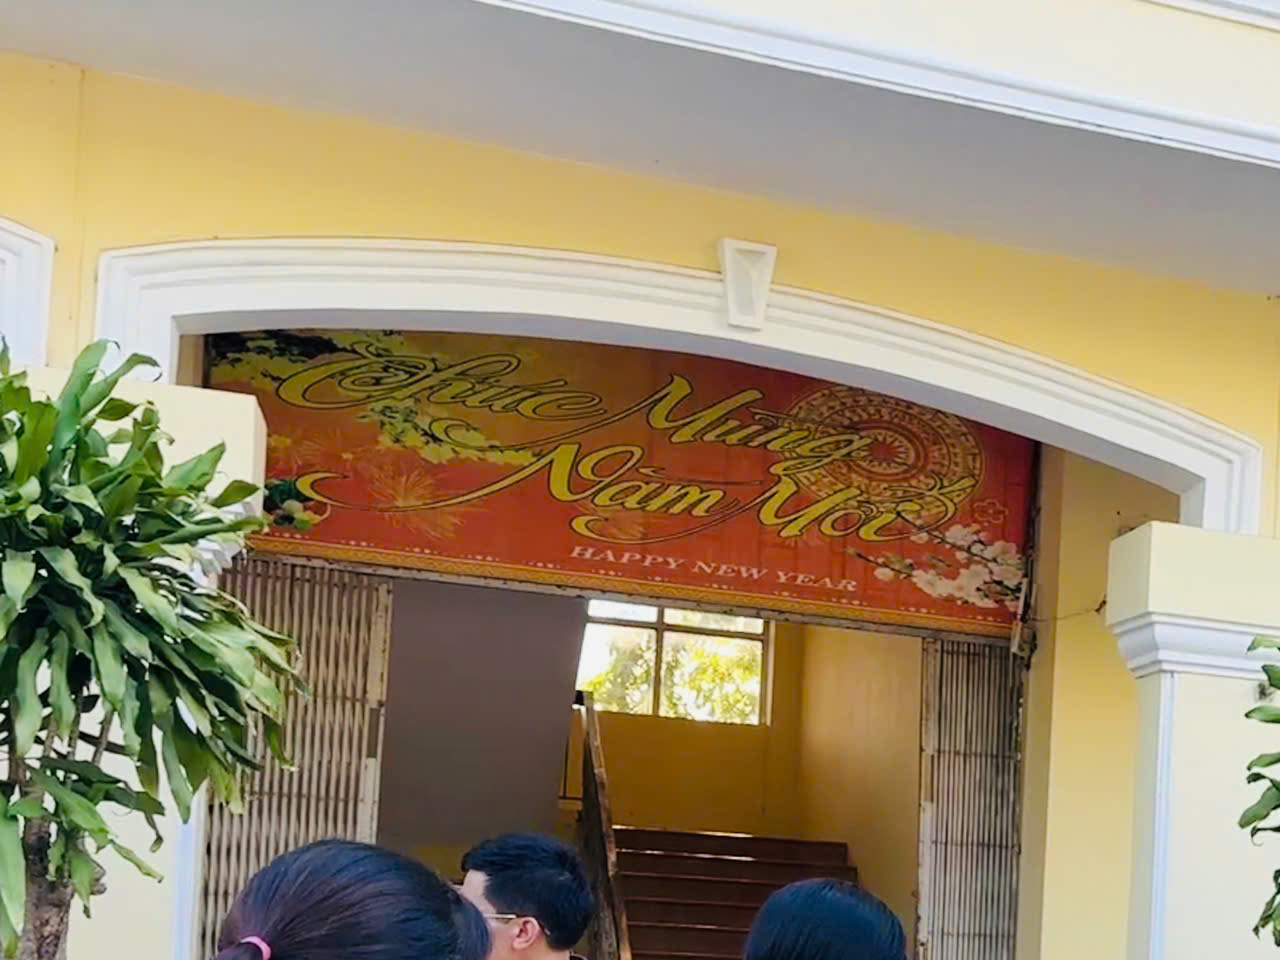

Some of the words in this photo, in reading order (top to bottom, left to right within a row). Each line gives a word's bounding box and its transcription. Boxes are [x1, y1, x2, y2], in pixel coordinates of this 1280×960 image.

[276, 340, 607, 421] Chúc
[570, 545, 685, 570] HAPPY
[691, 560, 768, 580] NEW
[775, 570, 859, 592] YEAR
